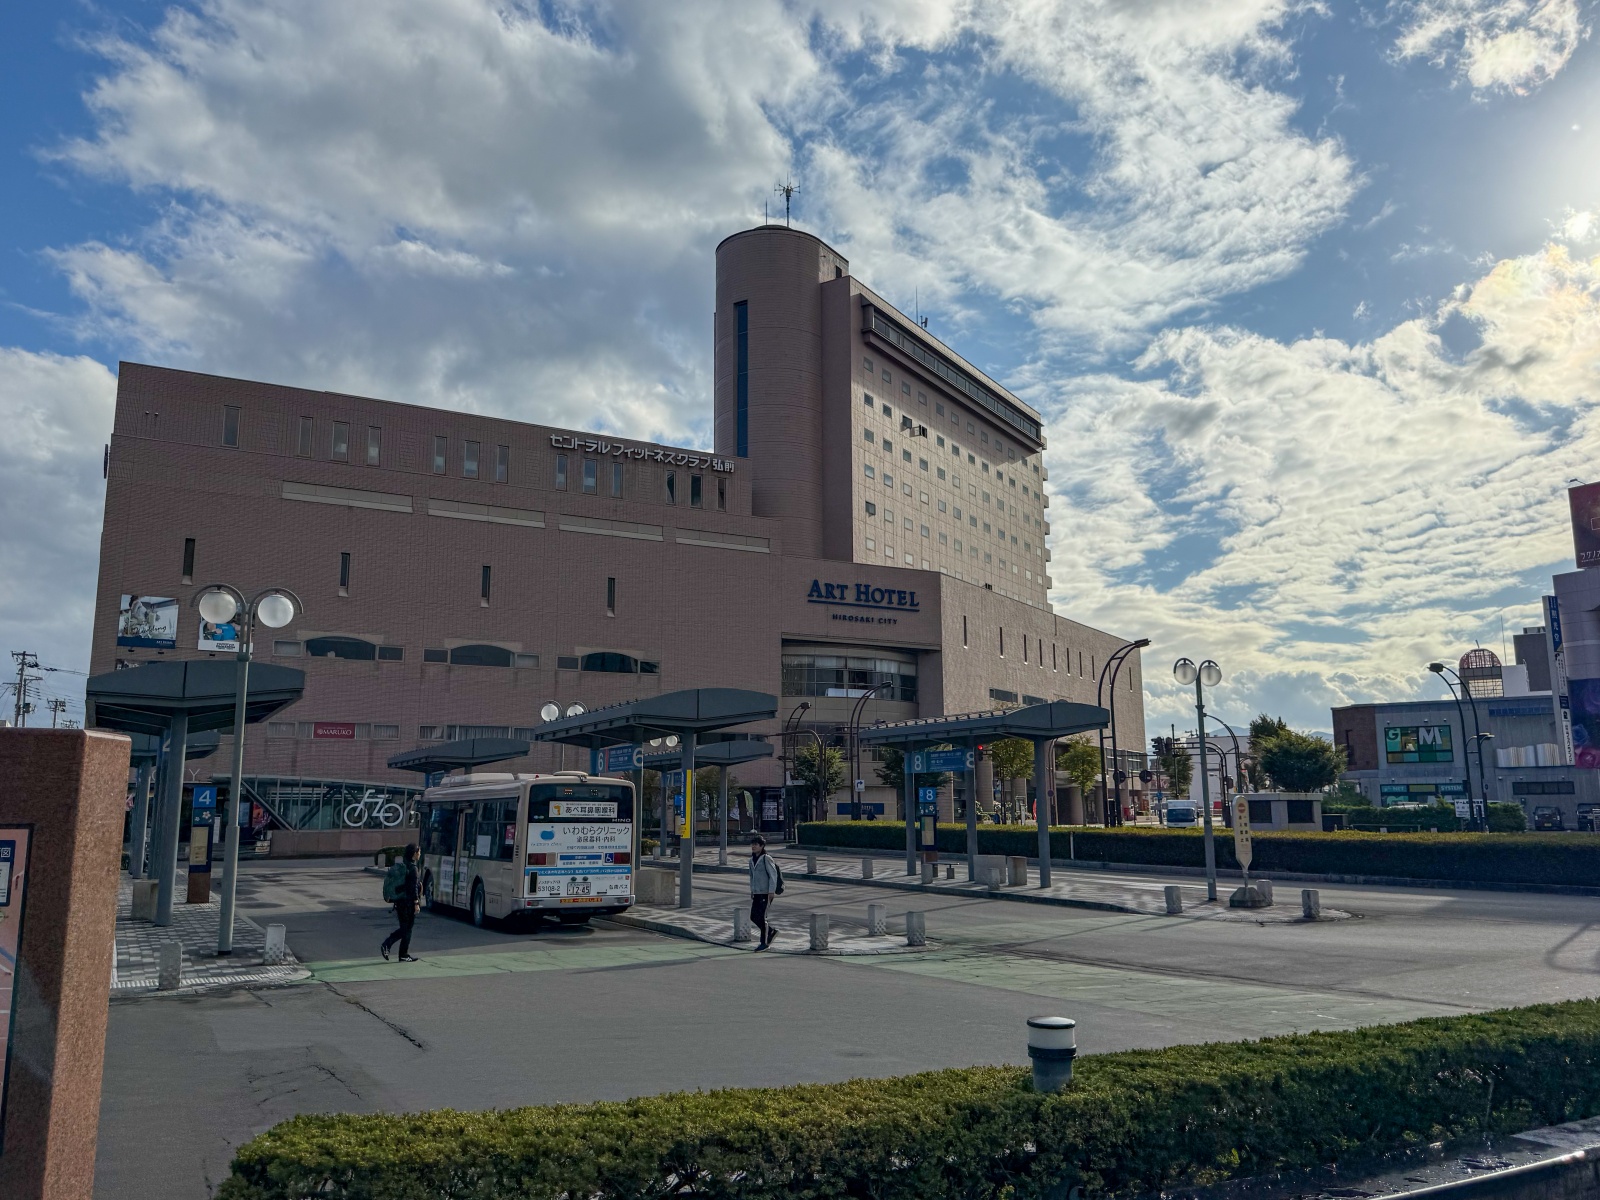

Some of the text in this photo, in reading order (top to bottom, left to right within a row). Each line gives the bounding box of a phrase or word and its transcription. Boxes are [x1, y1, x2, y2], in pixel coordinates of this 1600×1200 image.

[808, 579, 920, 607] ART HOTEL
[832, 613, 898, 625] HIROSAKI CITY
[597, 752, 604, 771] 6
[632, 747, 643, 767] 6
[914, 755, 922, 771] 8
[966, 751, 975, 768] 8
[198, 790, 211, 805] 4
[926, 789, 934, 801] 8
[563, 826, 630, 835] いわむらクリニック
